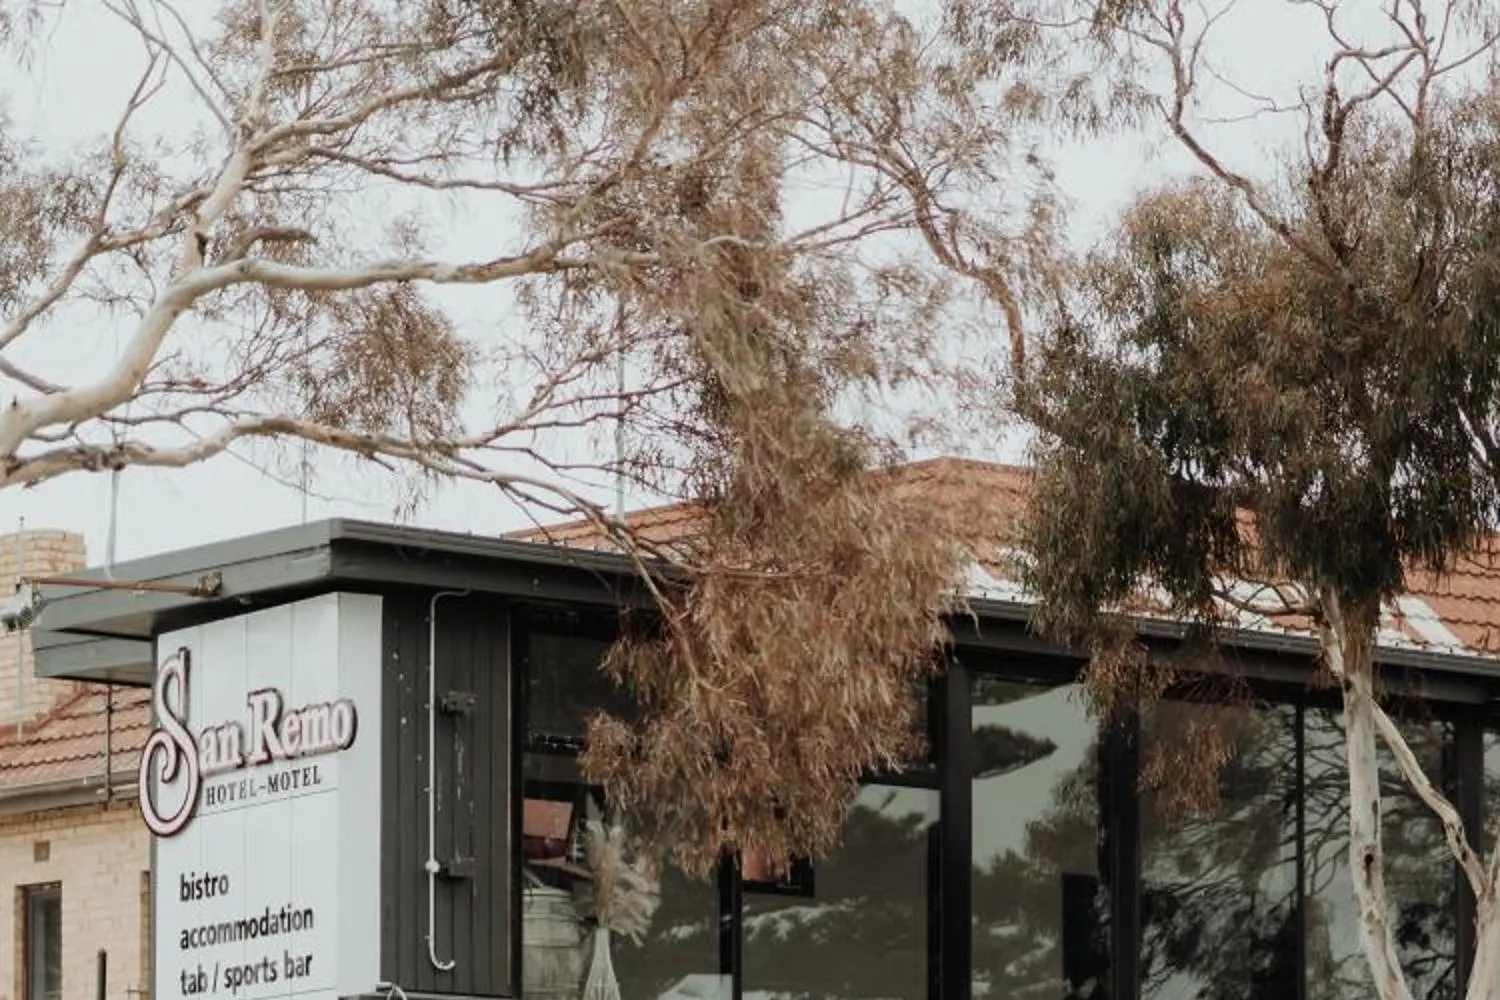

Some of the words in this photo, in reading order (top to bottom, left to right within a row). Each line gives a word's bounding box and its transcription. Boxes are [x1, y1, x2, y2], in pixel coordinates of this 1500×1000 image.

[139, 646, 246, 838] San
[248, 687, 358, 766] Remo
[180, 872, 230, 902] bistro
[180, 903, 314, 950] accommodation
[181, 963, 208, 996] tab
[224, 956, 278, 995] sports
[283, 950, 313, 979] bar
